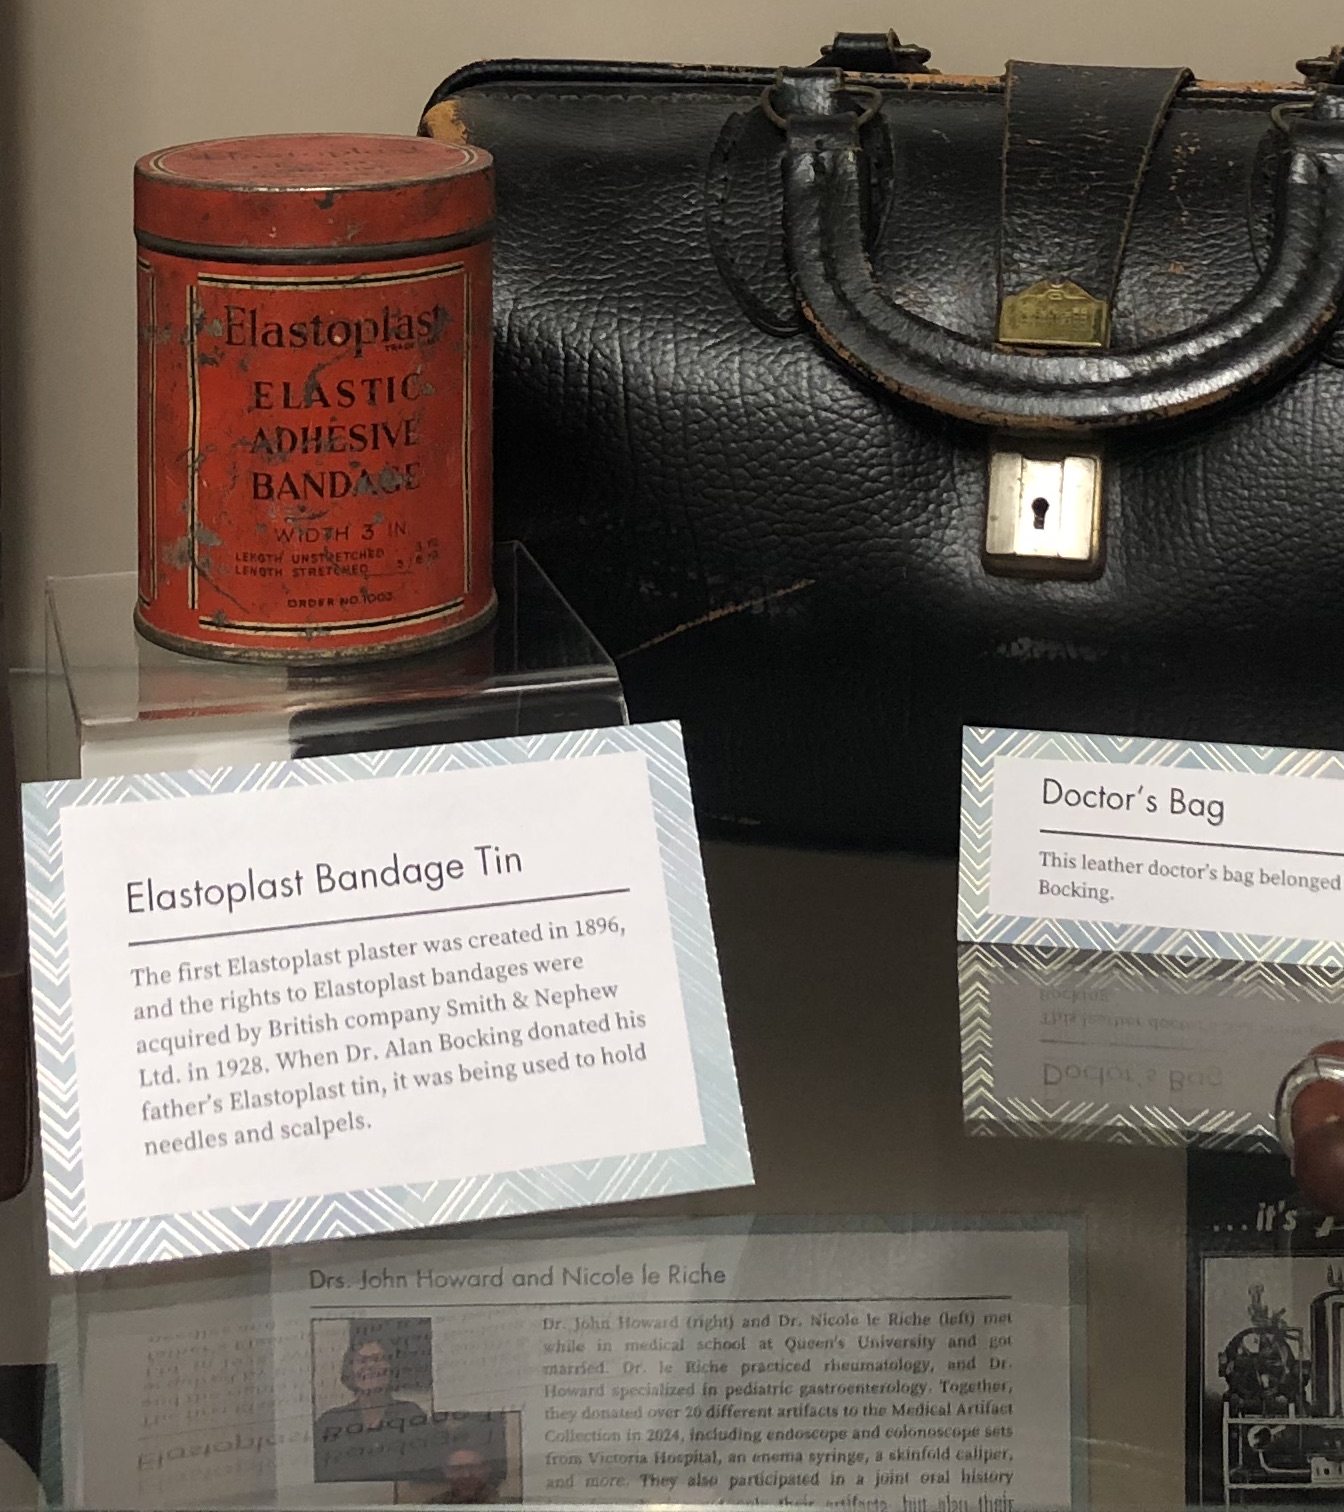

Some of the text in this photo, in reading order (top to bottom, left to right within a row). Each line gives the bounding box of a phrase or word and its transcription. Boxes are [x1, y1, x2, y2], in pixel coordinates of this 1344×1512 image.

[224, 305, 447, 358] Elastoplast
[253, 372, 423, 410] ELASTIC
[250, 419, 420, 455] ADHESIVE
[274, 525, 349, 543] WIDTH
[361, 524, 374, 540] 3
[1043, 778, 1224, 826] Doctor's Bag
[127, 845, 521, 913] Elastoplast Bandage Tin
[1039, 851, 1076, 869] This
[1082, 854, 1144, 874] leather
[1148, 859, 1217, 880] doctor's
[1223, 865, 1254, 887] bag
[1260, 868, 1341, 892] belonged
[1039, 879, 1114, 903] Bocking.
[131, 916, 625, 986] The first Elastoplast plaster was created in 1896,
[309, 1262, 726, 1290] Drs. John Howard and Nicole le Riche
